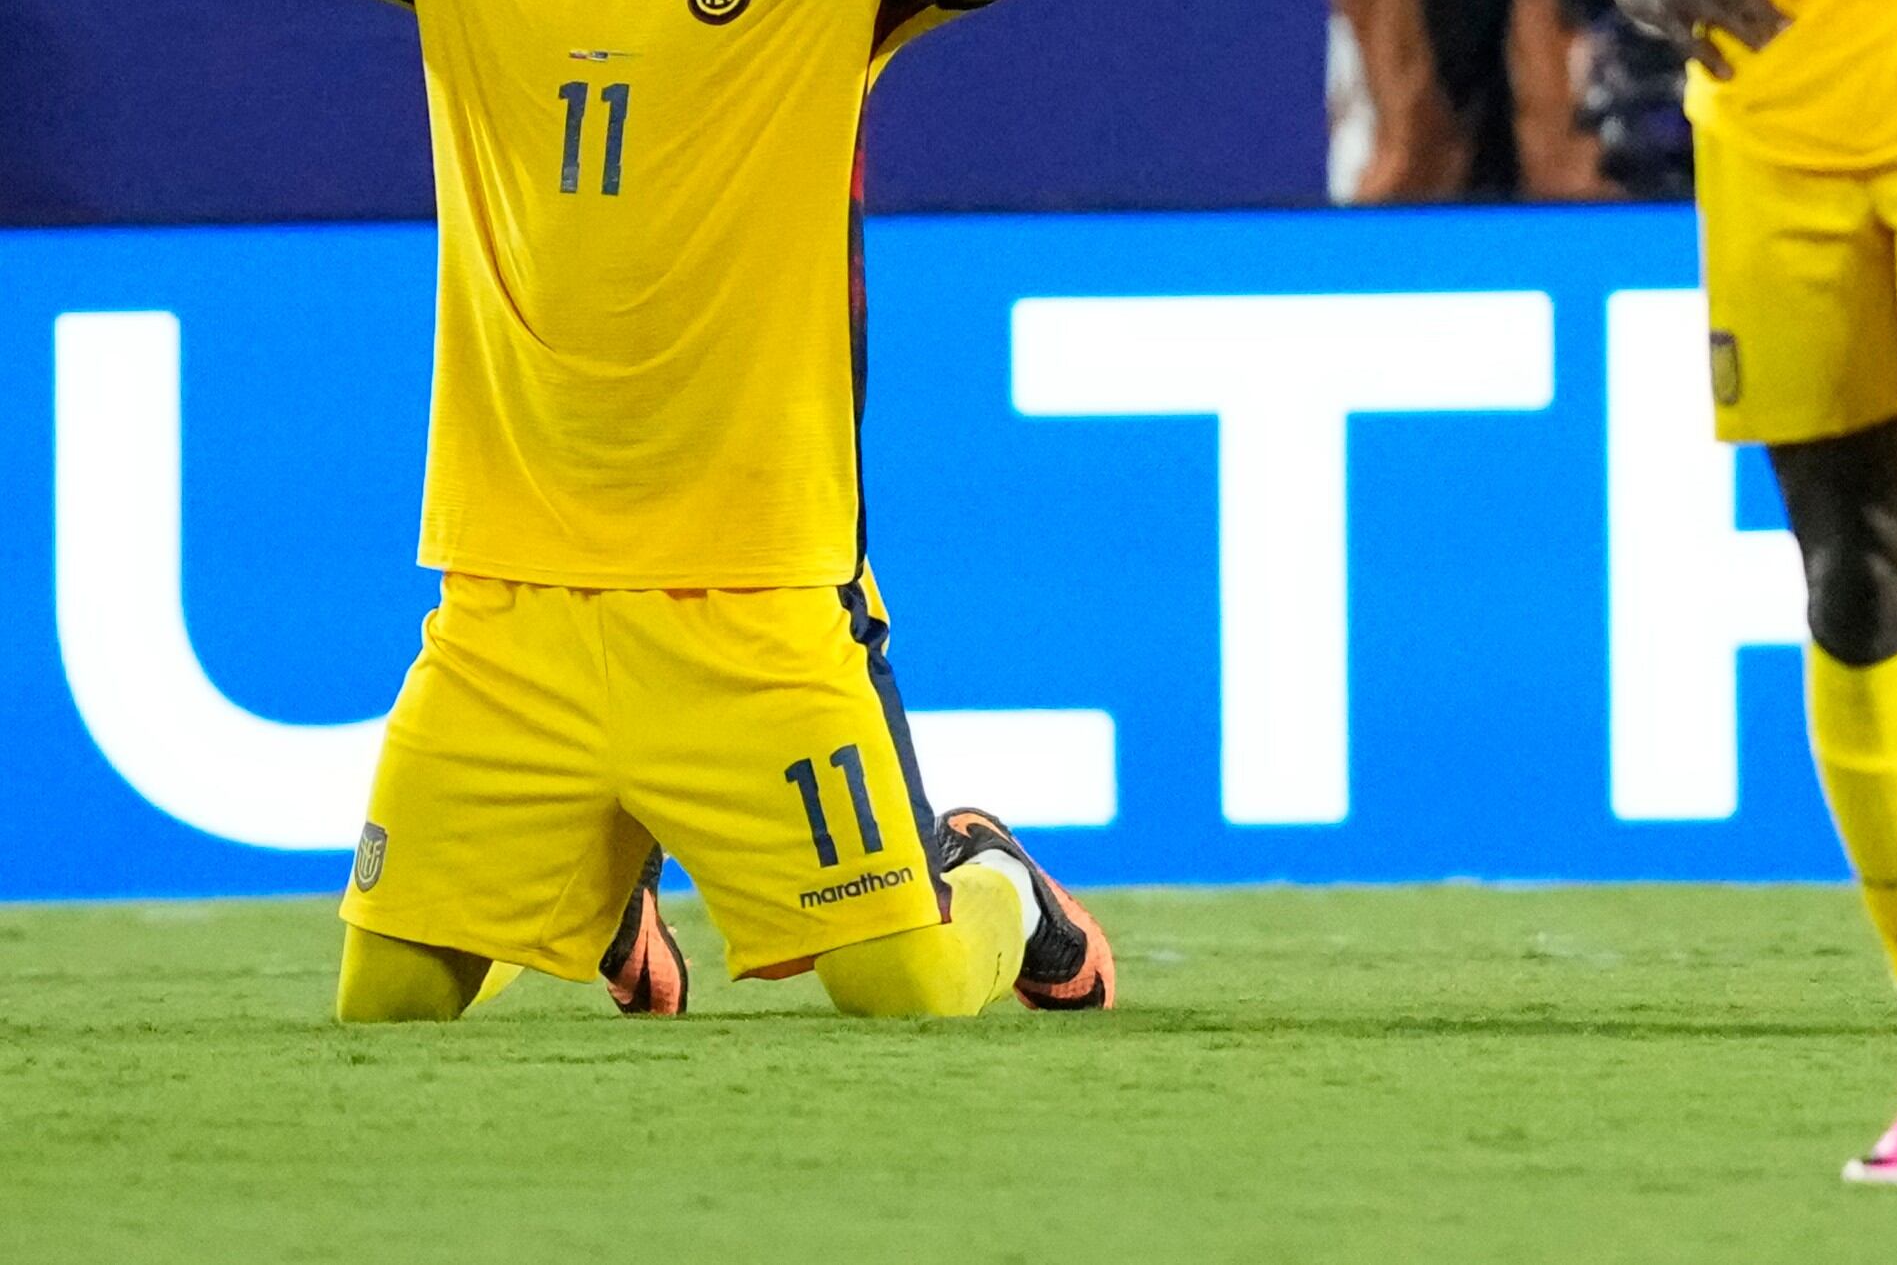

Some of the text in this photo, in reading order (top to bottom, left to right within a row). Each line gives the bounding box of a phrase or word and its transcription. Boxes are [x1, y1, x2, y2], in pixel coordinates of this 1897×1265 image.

[558, 81, 630, 196] 11
[784, 744, 884, 868] 11
[799, 867, 914, 909] marathon
